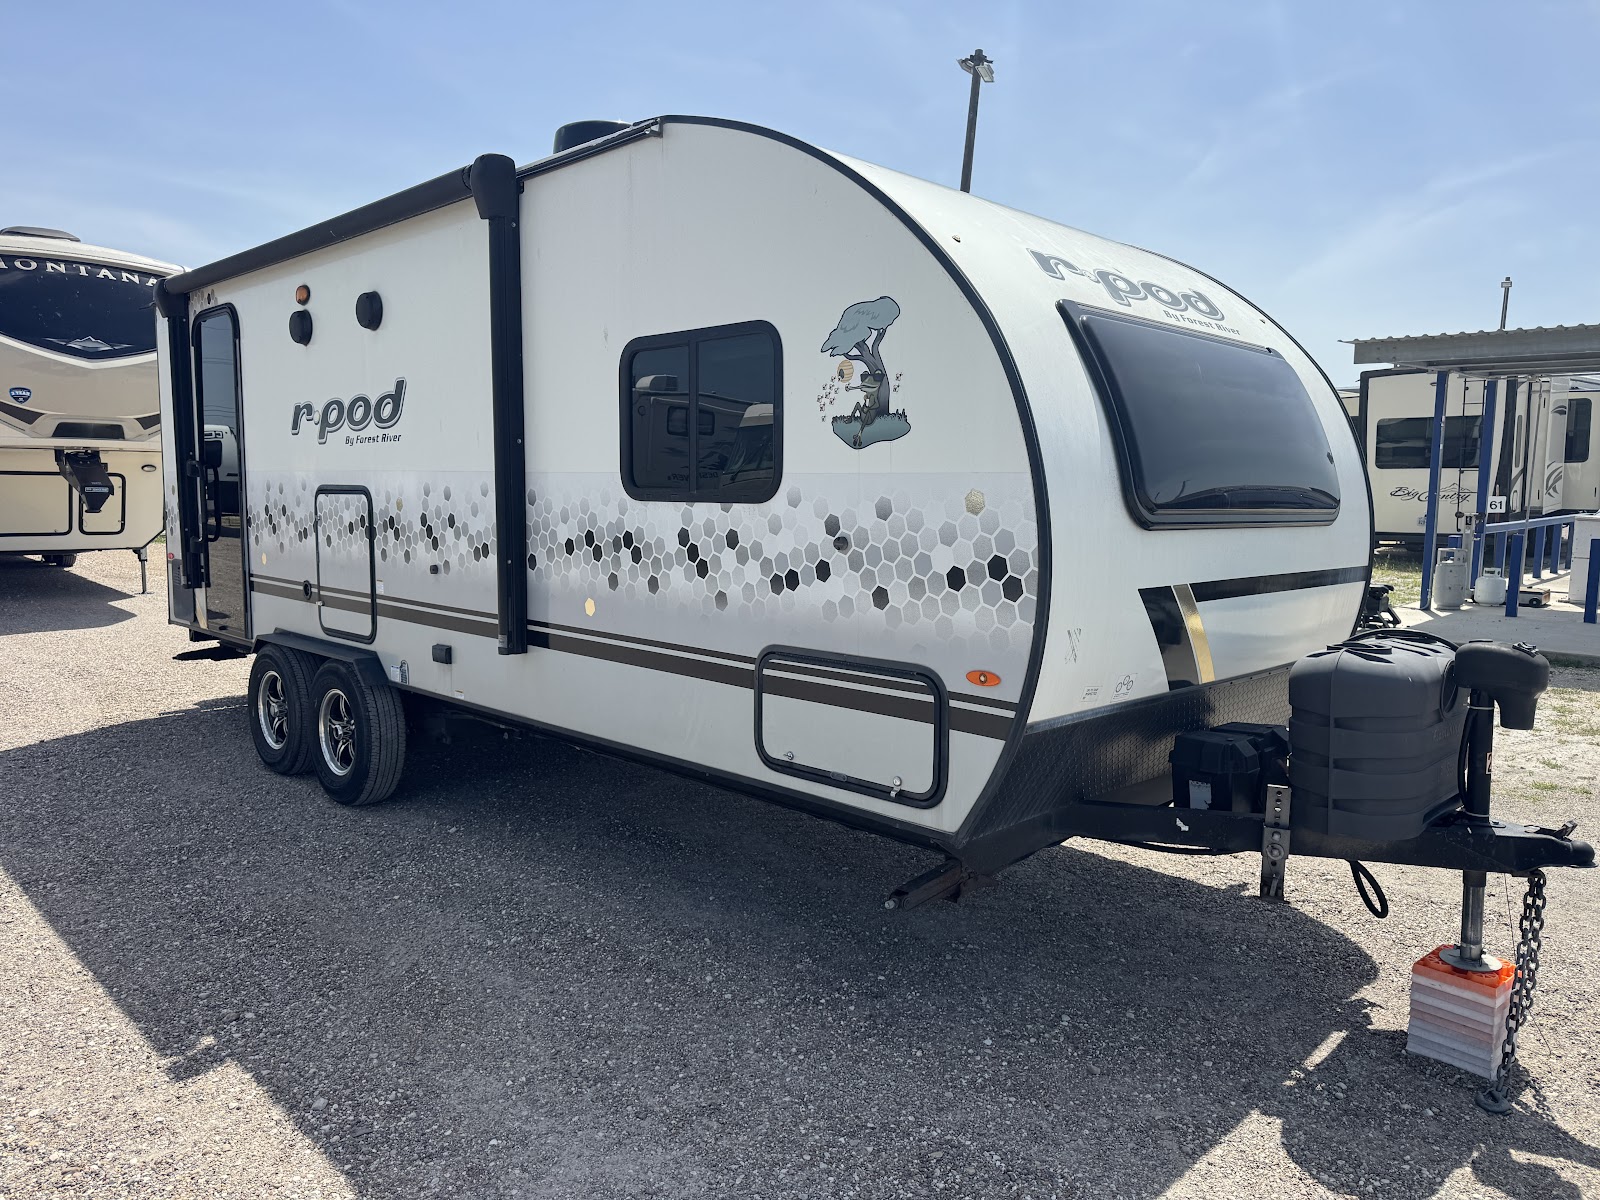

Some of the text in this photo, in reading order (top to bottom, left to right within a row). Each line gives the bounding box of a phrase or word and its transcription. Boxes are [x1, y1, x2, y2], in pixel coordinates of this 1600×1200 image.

[1163, 310, 1241, 335] By Forest River
[345, 433, 402, 446] By Forest River
[1390, 486, 1420, 501] Big
[1489, 500, 1503, 510] 61
